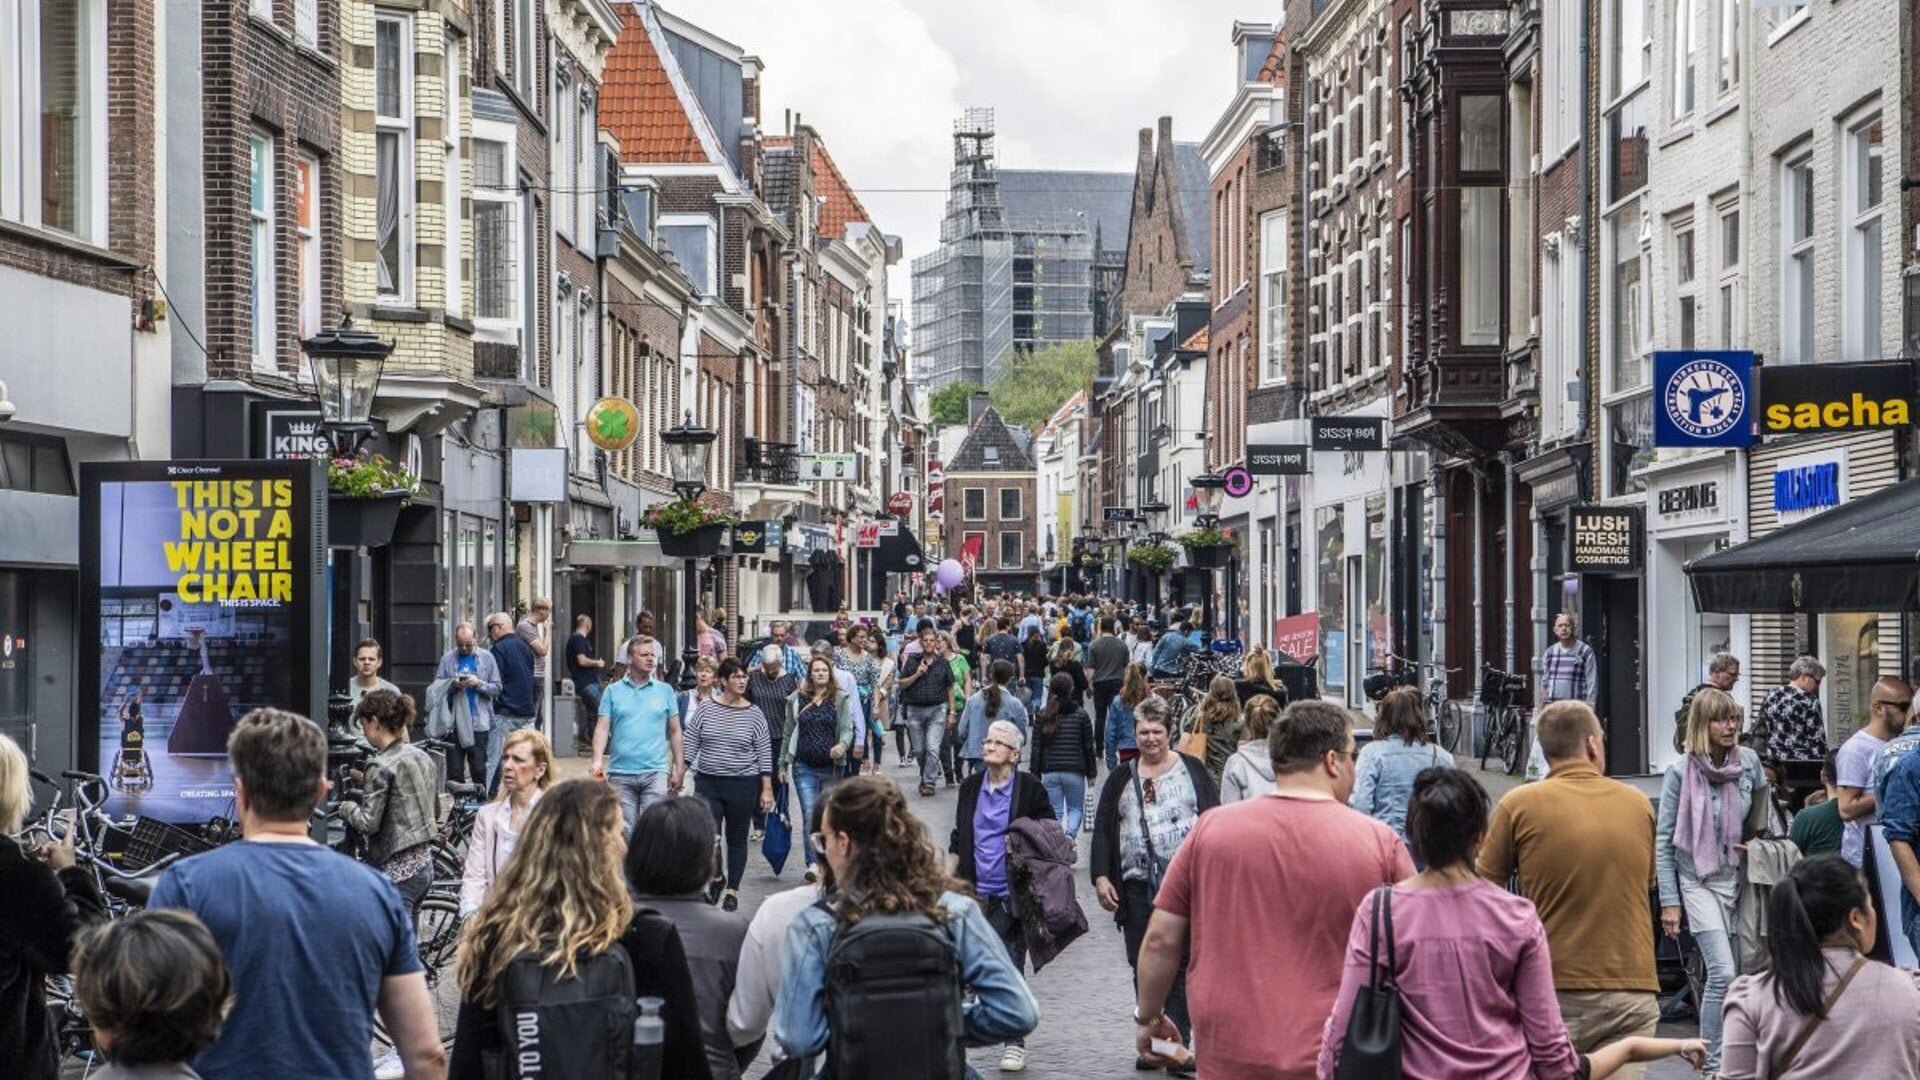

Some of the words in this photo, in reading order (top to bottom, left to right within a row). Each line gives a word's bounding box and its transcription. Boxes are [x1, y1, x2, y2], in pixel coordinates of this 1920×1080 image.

[1672, 362, 1736, 386] BIRKENSTOCK
[1767, 393, 1910, 429] sacha
[275, 436, 328, 453] KING
[171, 480, 254, 508] THIS
[262, 479, 292, 508] IS
[1659, 481, 1718, 515] BERING
[181, 509, 261, 540] NOT
[266, 509, 292, 539] A
[1575, 515, 1630, 531] LUSH
[1575, 532, 1630, 546] FRESH
[1575, 546, 1630, 556] HANDMADE
[163, 541, 292, 571] WHEEL
[1575, 556, 1630, 565] COSMETICS
[177, 572, 292, 603] CHAIR
[218, 598, 239, 607] THIS
[1279, 637, 1313, 659] SALE
[516, 1012, 540, 1049] YOU
[518, 1051, 542, 1076] TO
